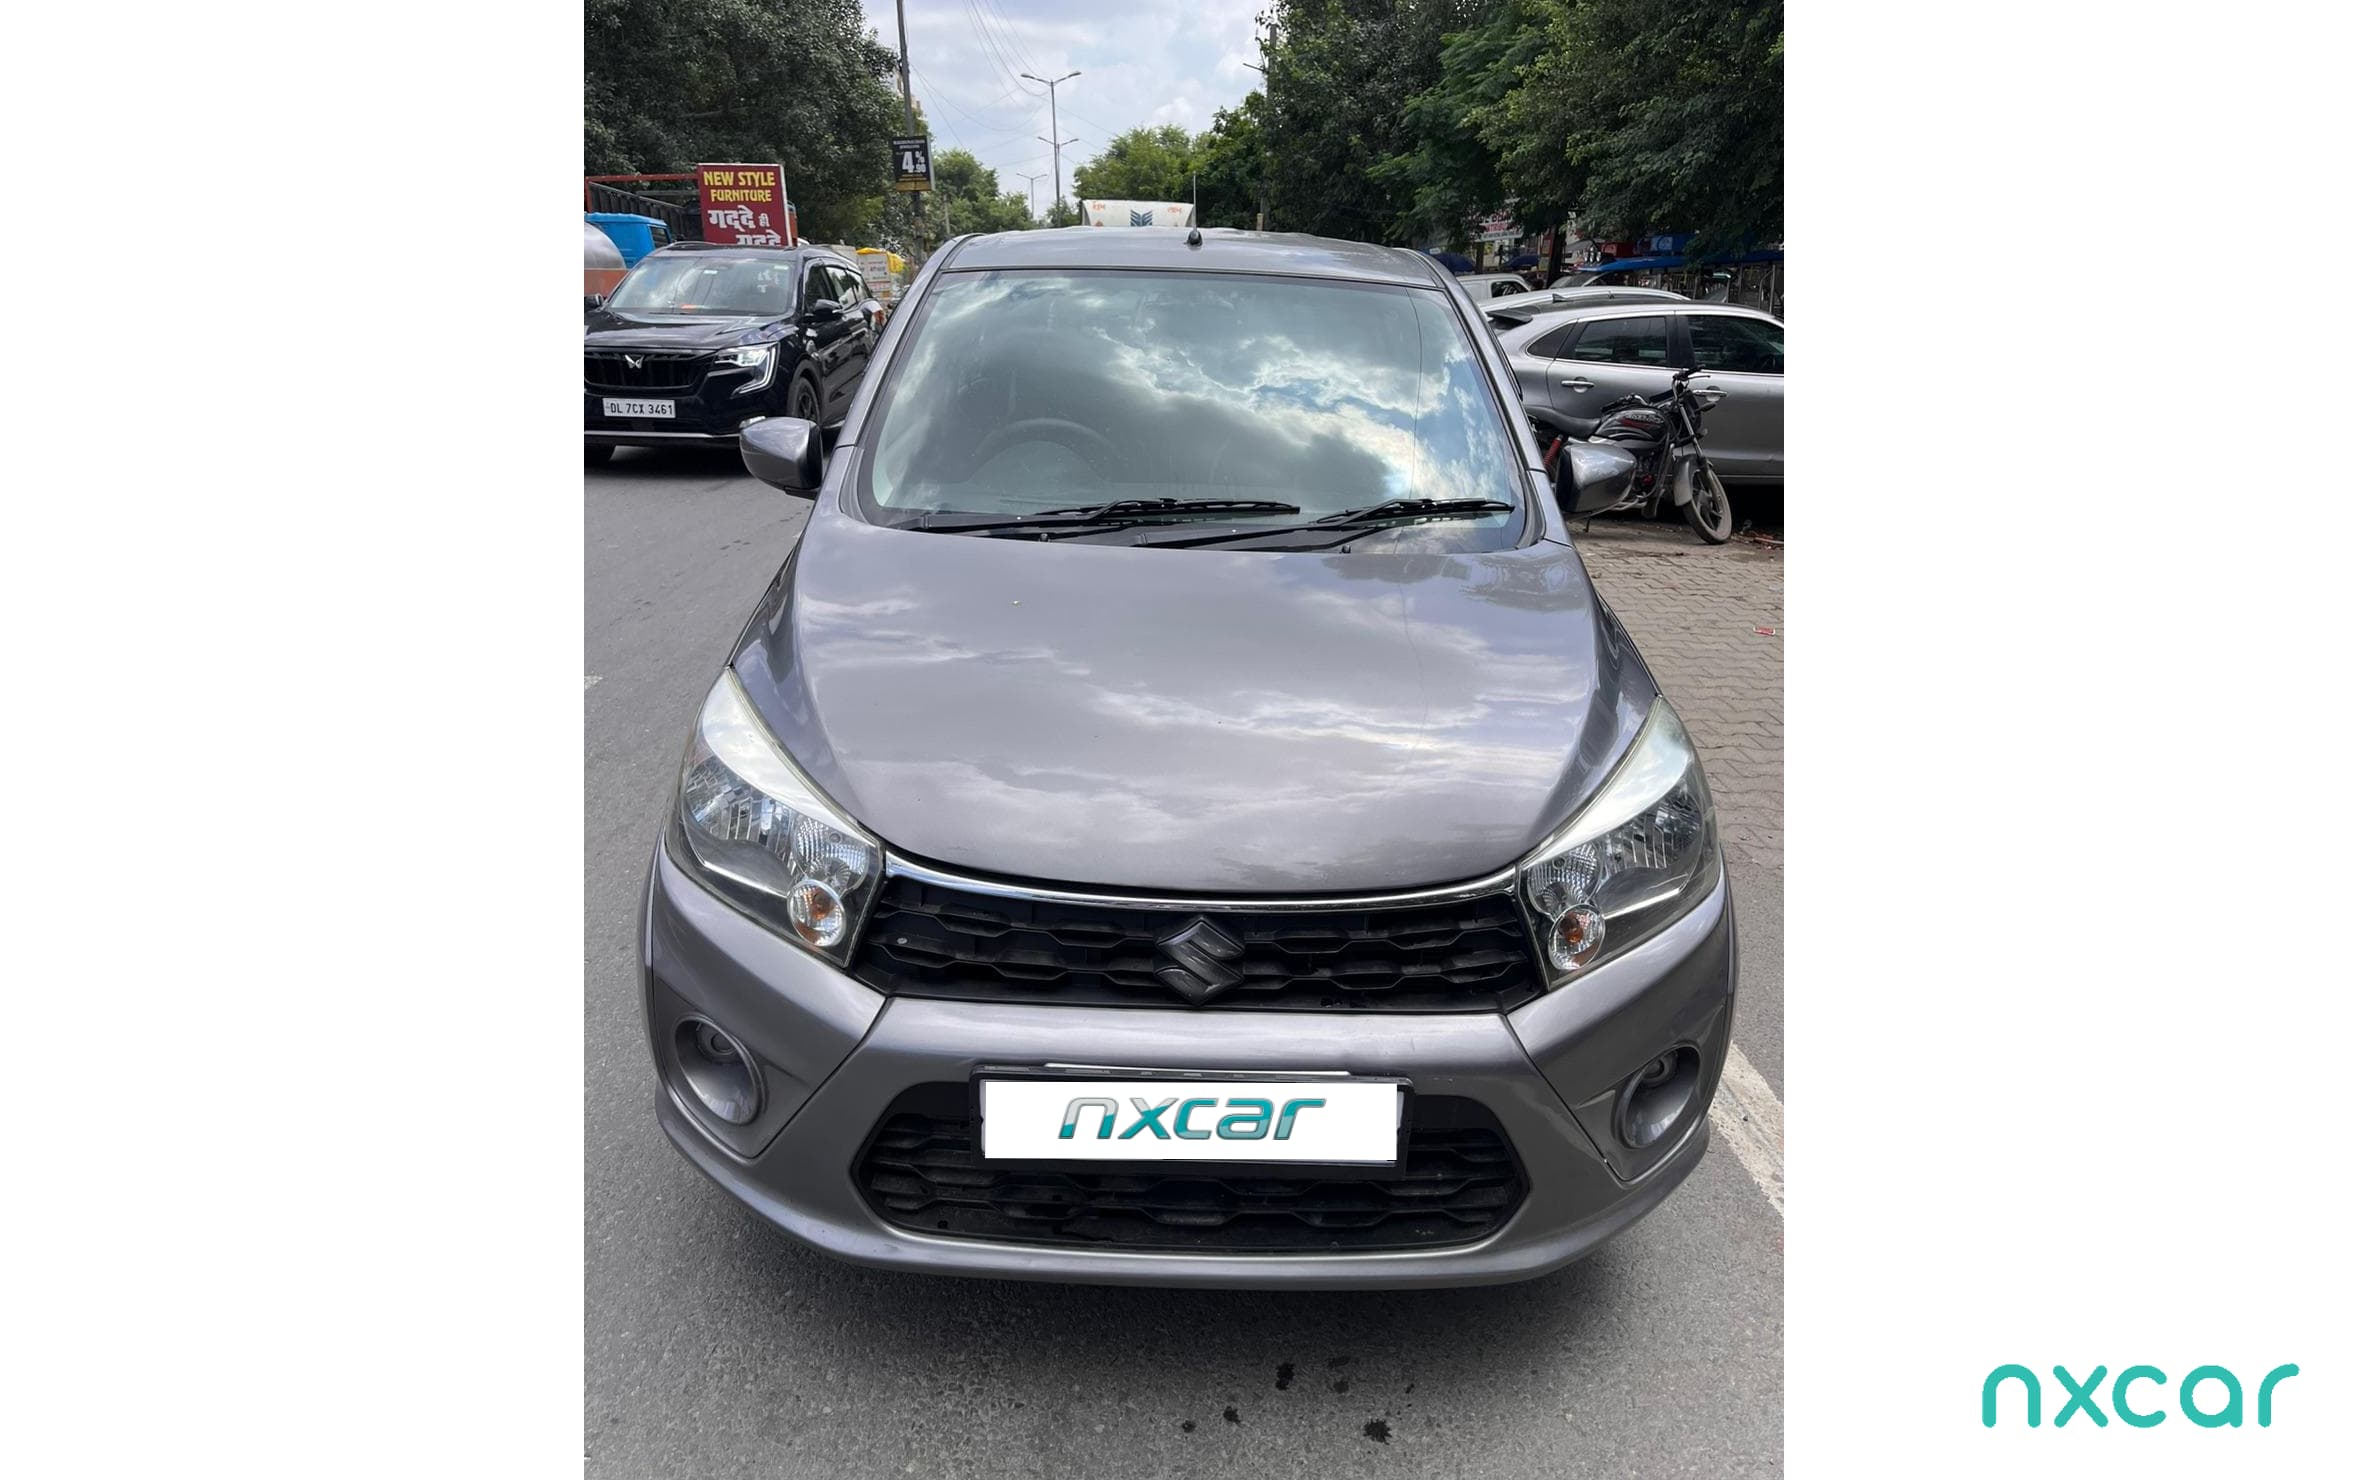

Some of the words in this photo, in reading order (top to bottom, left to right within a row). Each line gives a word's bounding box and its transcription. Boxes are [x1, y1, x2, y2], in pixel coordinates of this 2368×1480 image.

[902, 151, 914, 173] 4
[703, 171, 734, 186] NEW
[737, 171, 776, 187] STYLE
[710, 189, 772, 202] FURNITURE
[610, 402, 623, 413] DL
[626, 403, 645, 414] 7CX
[648, 404, 673, 415] 3461
